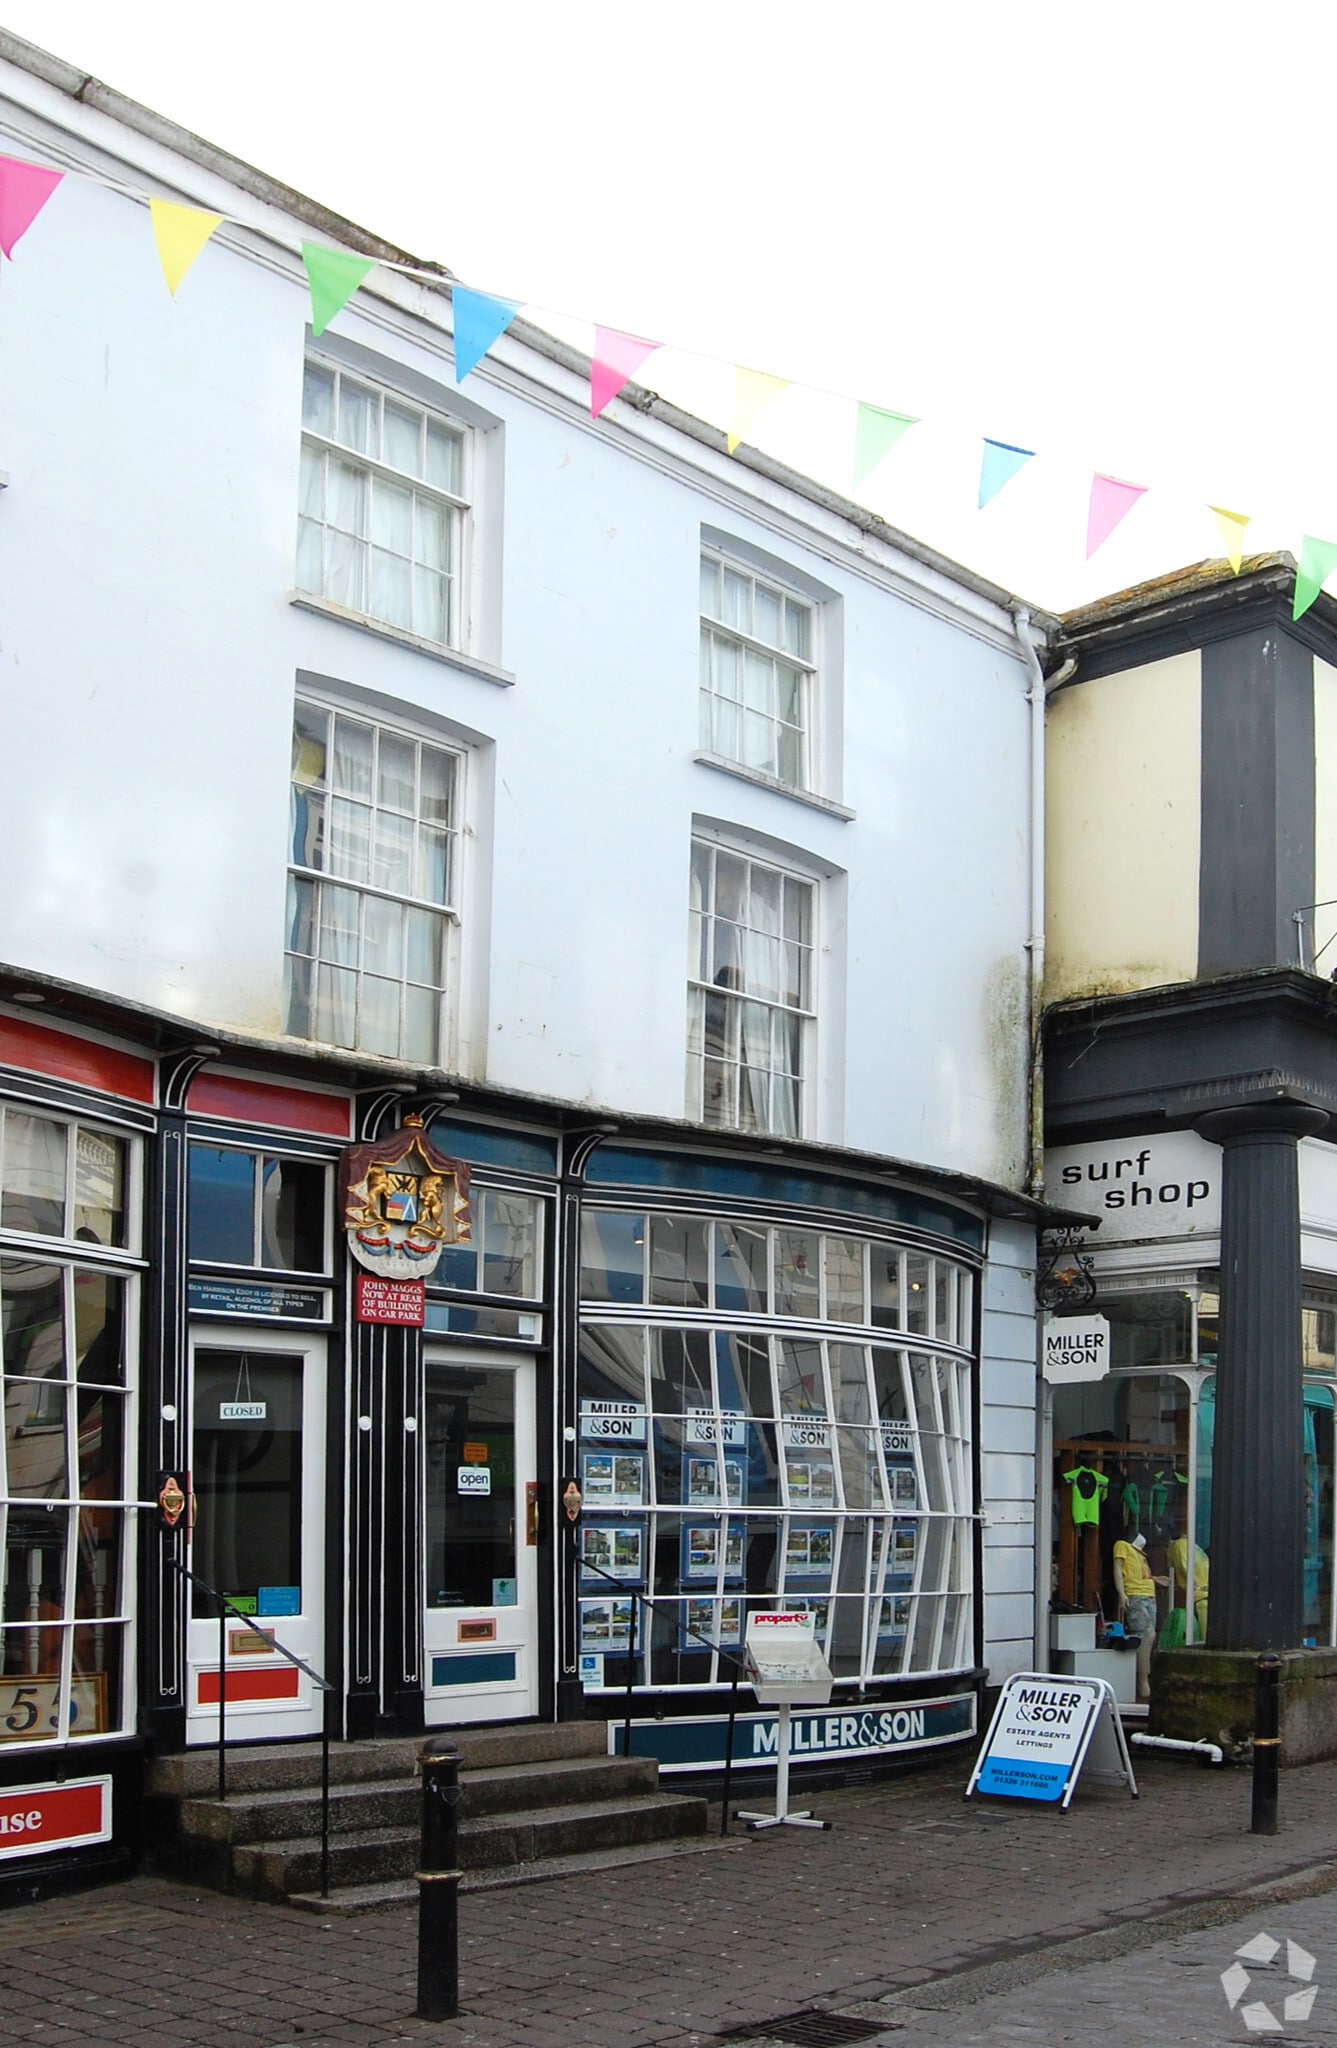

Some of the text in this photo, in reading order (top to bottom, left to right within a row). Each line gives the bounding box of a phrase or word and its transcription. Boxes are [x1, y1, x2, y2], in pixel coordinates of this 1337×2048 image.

[1062, 1150, 1151, 1184] surf
[1104, 1180, 1210, 1209] shop
[363, 1281, 422, 1295] JOHN MAGGS
[362, 1289, 422, 1304] NOW AT REAR
[362, 1299, 421, 1312] OF BUILDING
[362, 1308, 421, 1321] ON CAR PARK
[1047, 1333, 1104, 1351] MILLER
[1047, 1349, 1097, 1366] &SON
[223, 1407, 263, 1417] CLOSED
[591, 1402, 637, 1419] MILLER
[695, 1410, 737, 1426] MILER
[590, 1419, 632, 1435] &SON
[790, 1430, 825, 1445] &SON
[460, 1474, 489, 1486] open
[1018, 1689, 1082, 1709] MILLER
[1015, 1704, 1073, 1724] &SON
[1006, 1727, 1071, 1740] ESTATE AGENTS
[1016, 1739, 1053, 1749] LETTINGS
